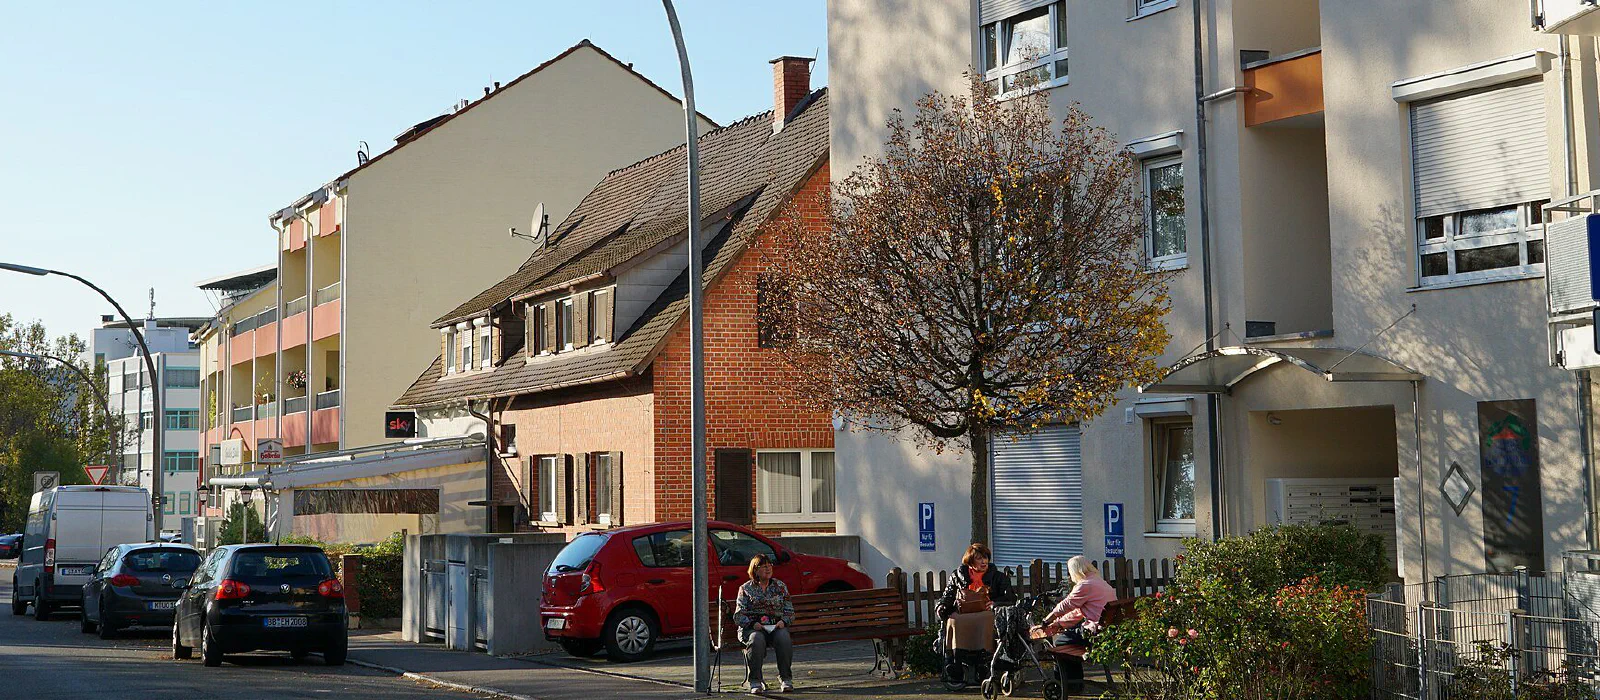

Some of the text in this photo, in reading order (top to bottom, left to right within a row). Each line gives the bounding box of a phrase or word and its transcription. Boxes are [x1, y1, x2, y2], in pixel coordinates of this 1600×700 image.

[389, 417, 411, 432] sky
[1503, 486, 1519, 523] 7
[922, 503, 932, 530] P
[1108, 504, 1120, 533] P
[1105, 546, 1124, 555] Besucher
[1106, 538, 1115, 546] Nur
